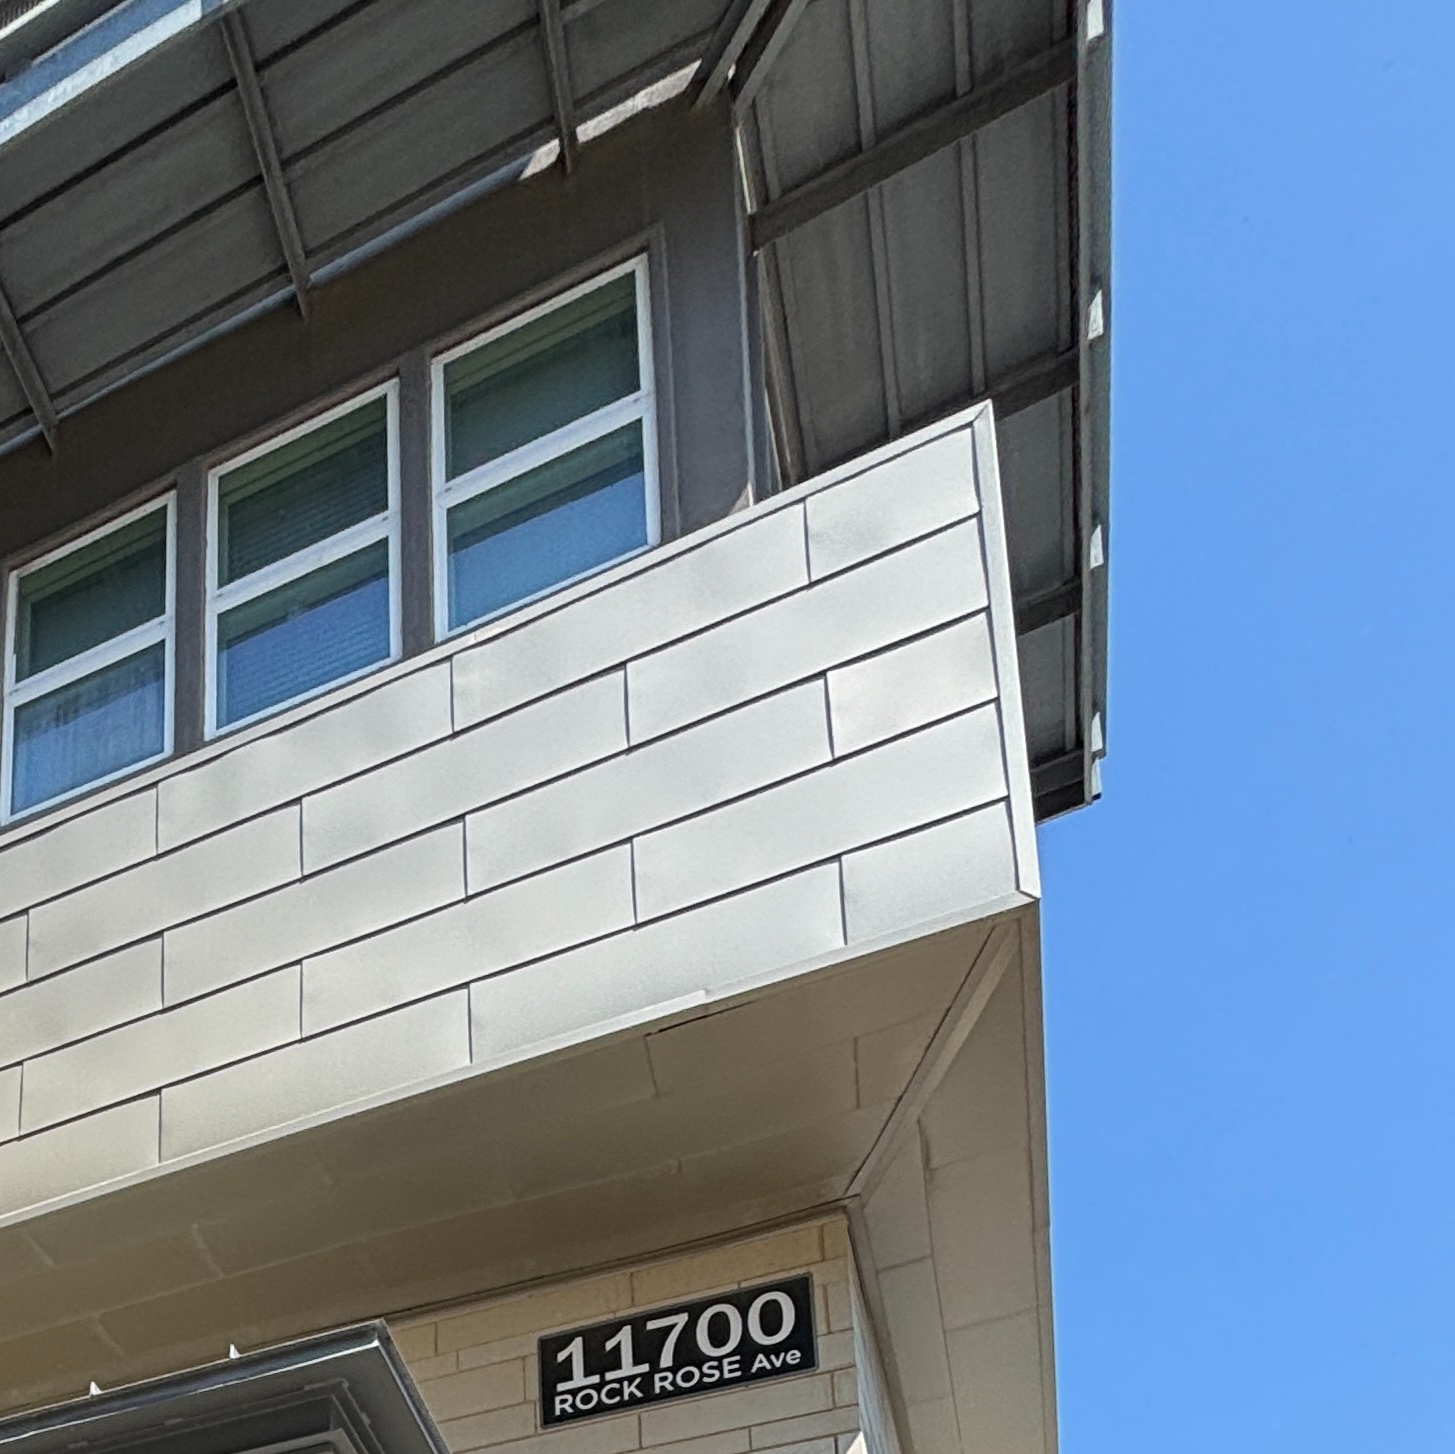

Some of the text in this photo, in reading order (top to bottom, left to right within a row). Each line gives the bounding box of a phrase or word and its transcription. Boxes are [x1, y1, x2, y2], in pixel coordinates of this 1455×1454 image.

[554, 1349, 802, 1416] ROCK ROSE Ave
[556, 1291, 796, 1392] 11700
